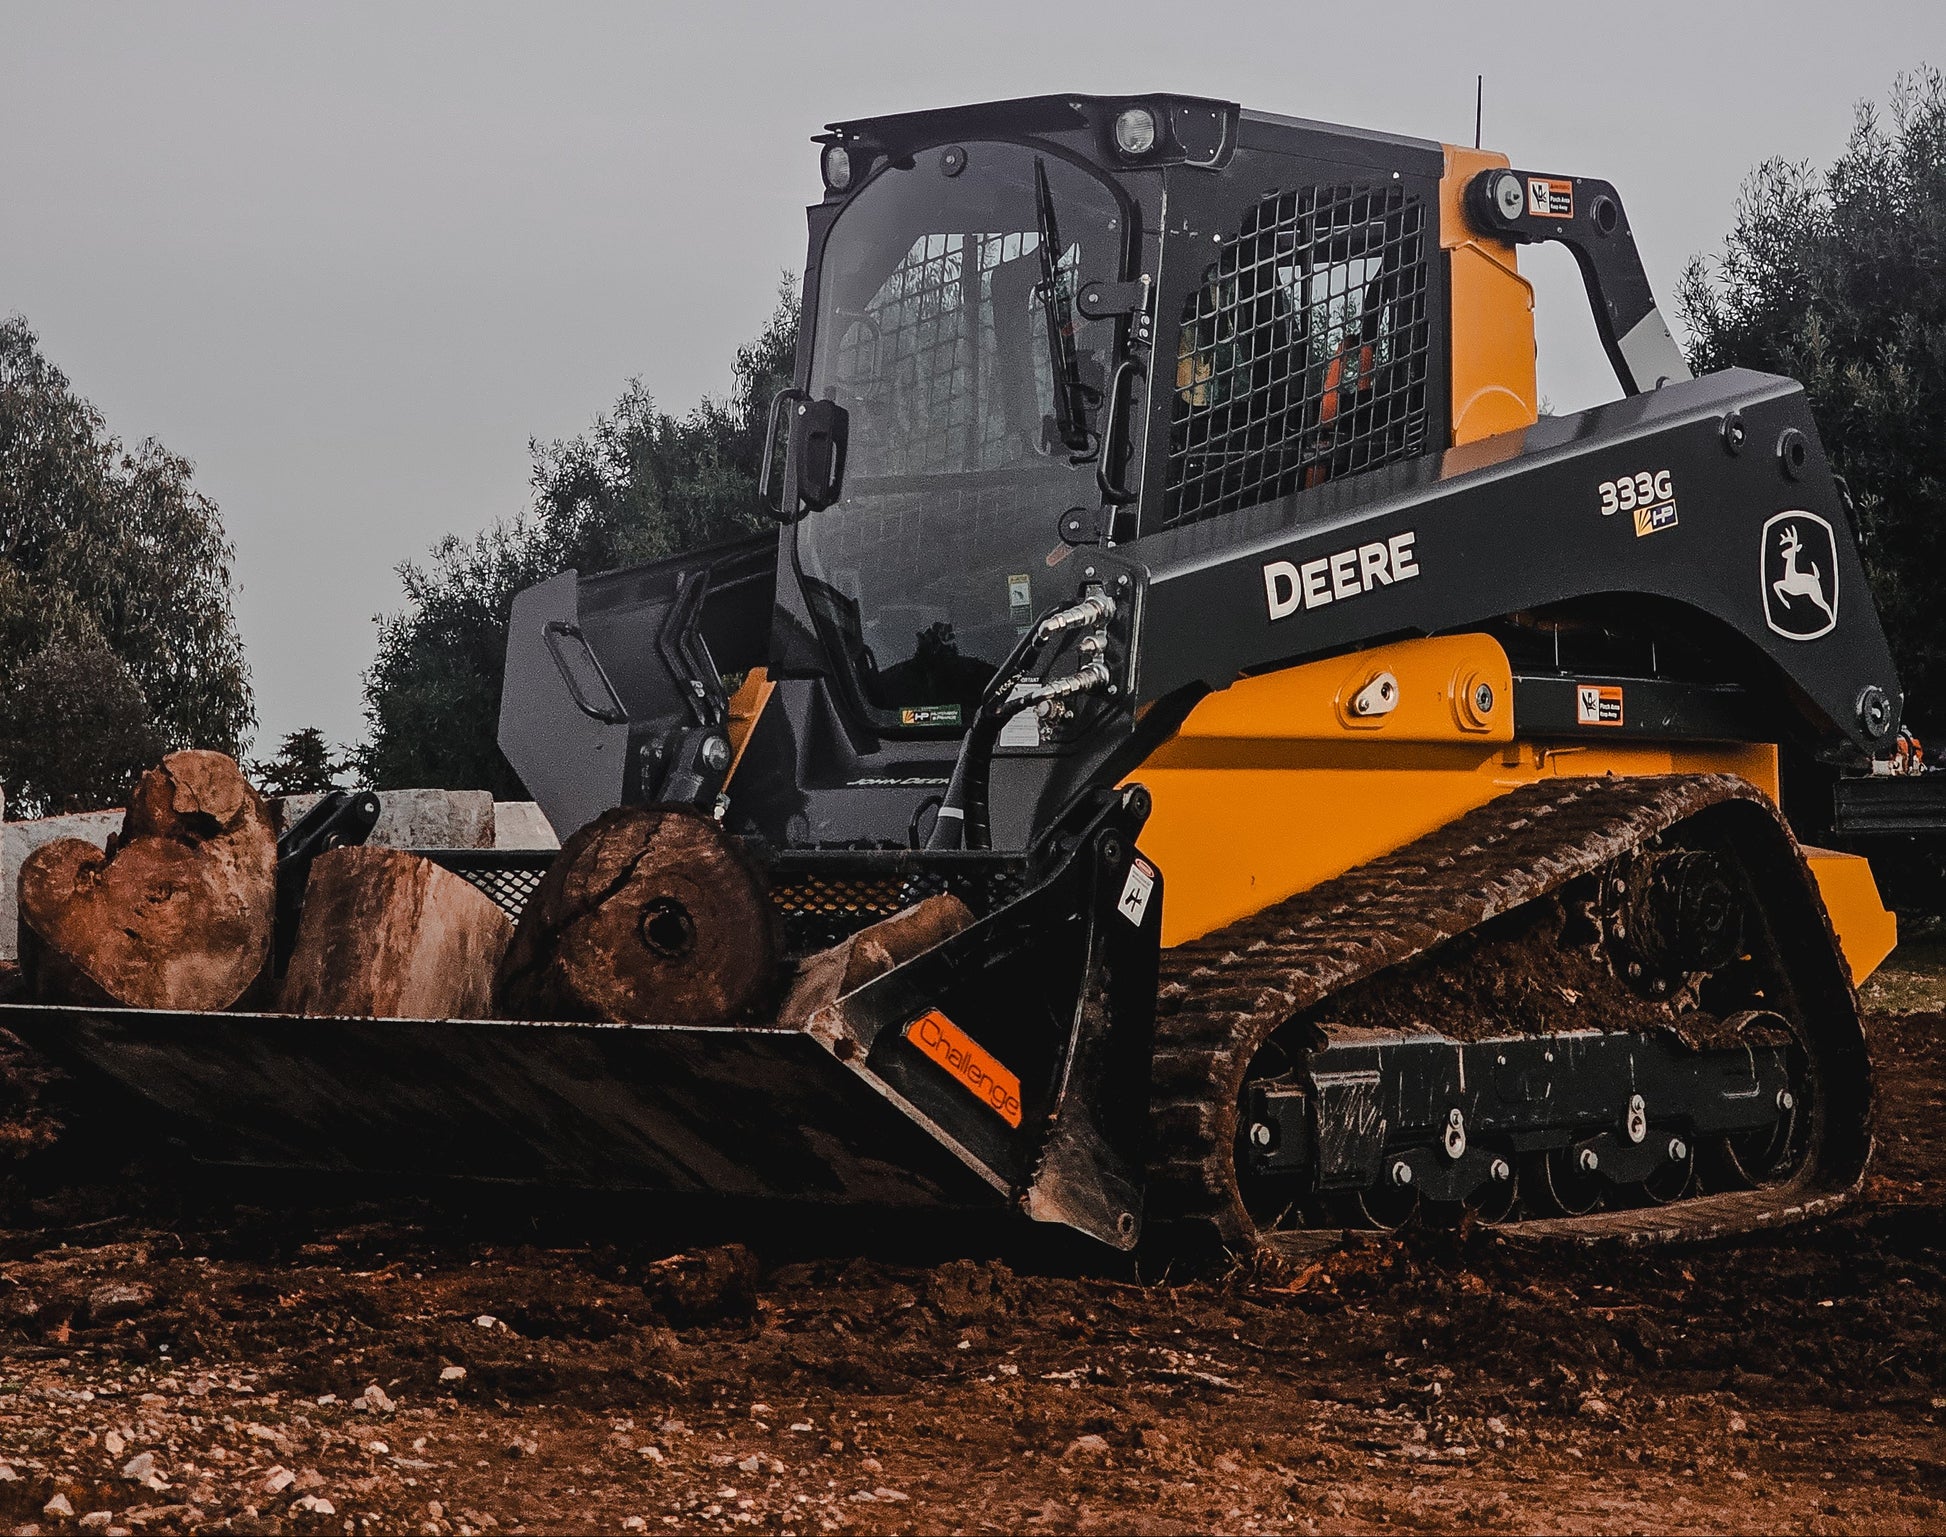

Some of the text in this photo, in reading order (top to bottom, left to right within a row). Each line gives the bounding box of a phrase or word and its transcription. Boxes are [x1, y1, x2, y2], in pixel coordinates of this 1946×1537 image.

[1599, 470, 1673, 516] 333G
[1653, 505, 1674, 526] HP
[1263, 531, 1419, 621] DEERE
[846, 777, 950, 786] JOHN DEER
[920, 1018, 1020, 1117] Challenge
